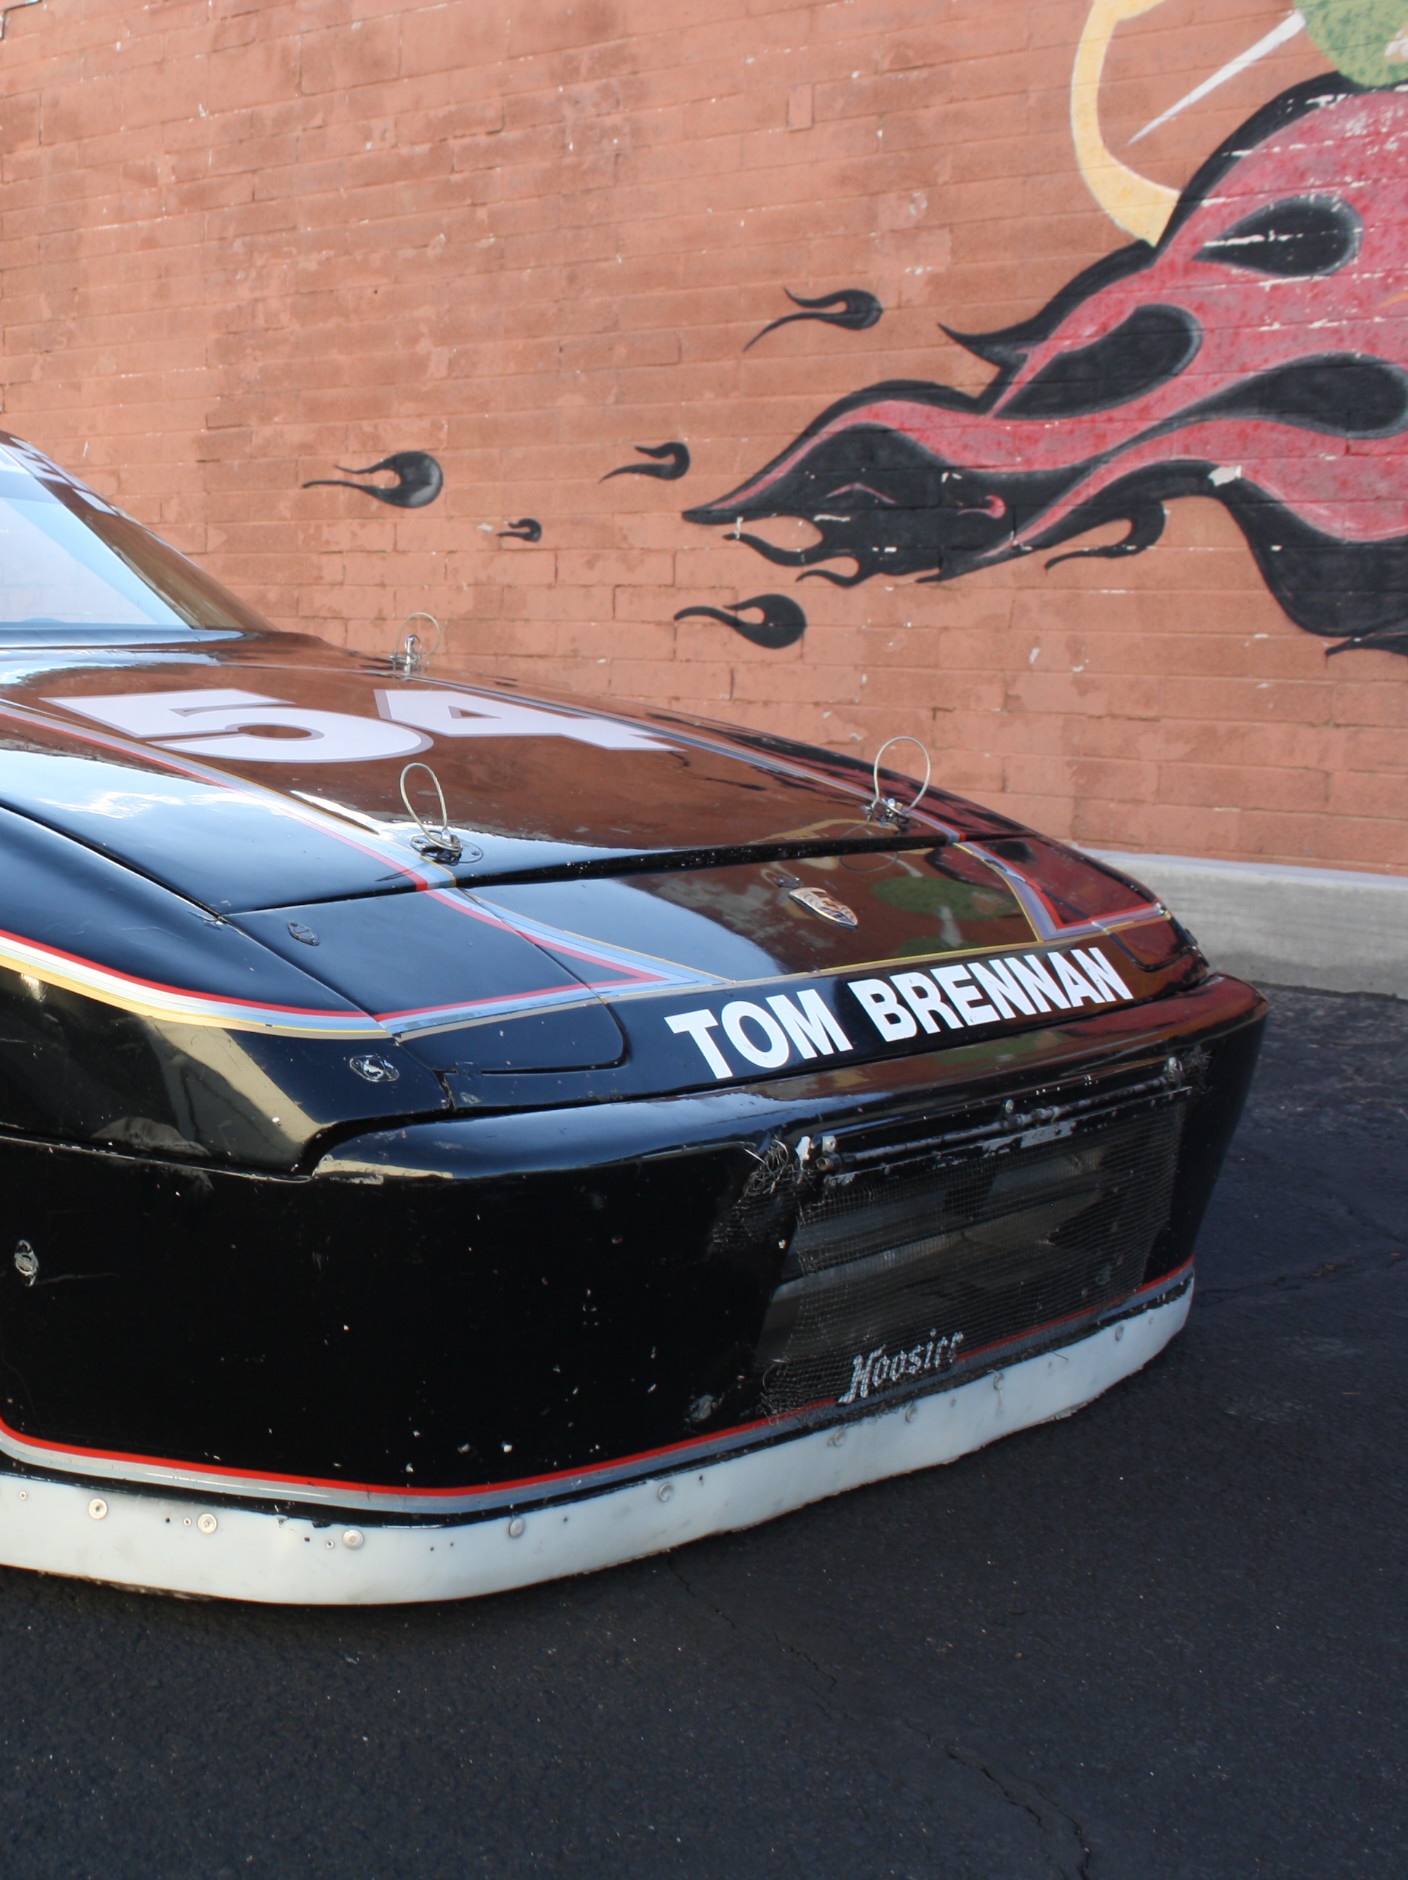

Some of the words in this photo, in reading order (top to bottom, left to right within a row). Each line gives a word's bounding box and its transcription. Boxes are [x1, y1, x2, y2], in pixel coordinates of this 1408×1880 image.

[38, 688, 687, 764] 54
[664, 989, 854, 1080] TOM
[847, 946, 1135, 1043] BRENNAN
[837, 1328, 964, 1404] Hoosier
